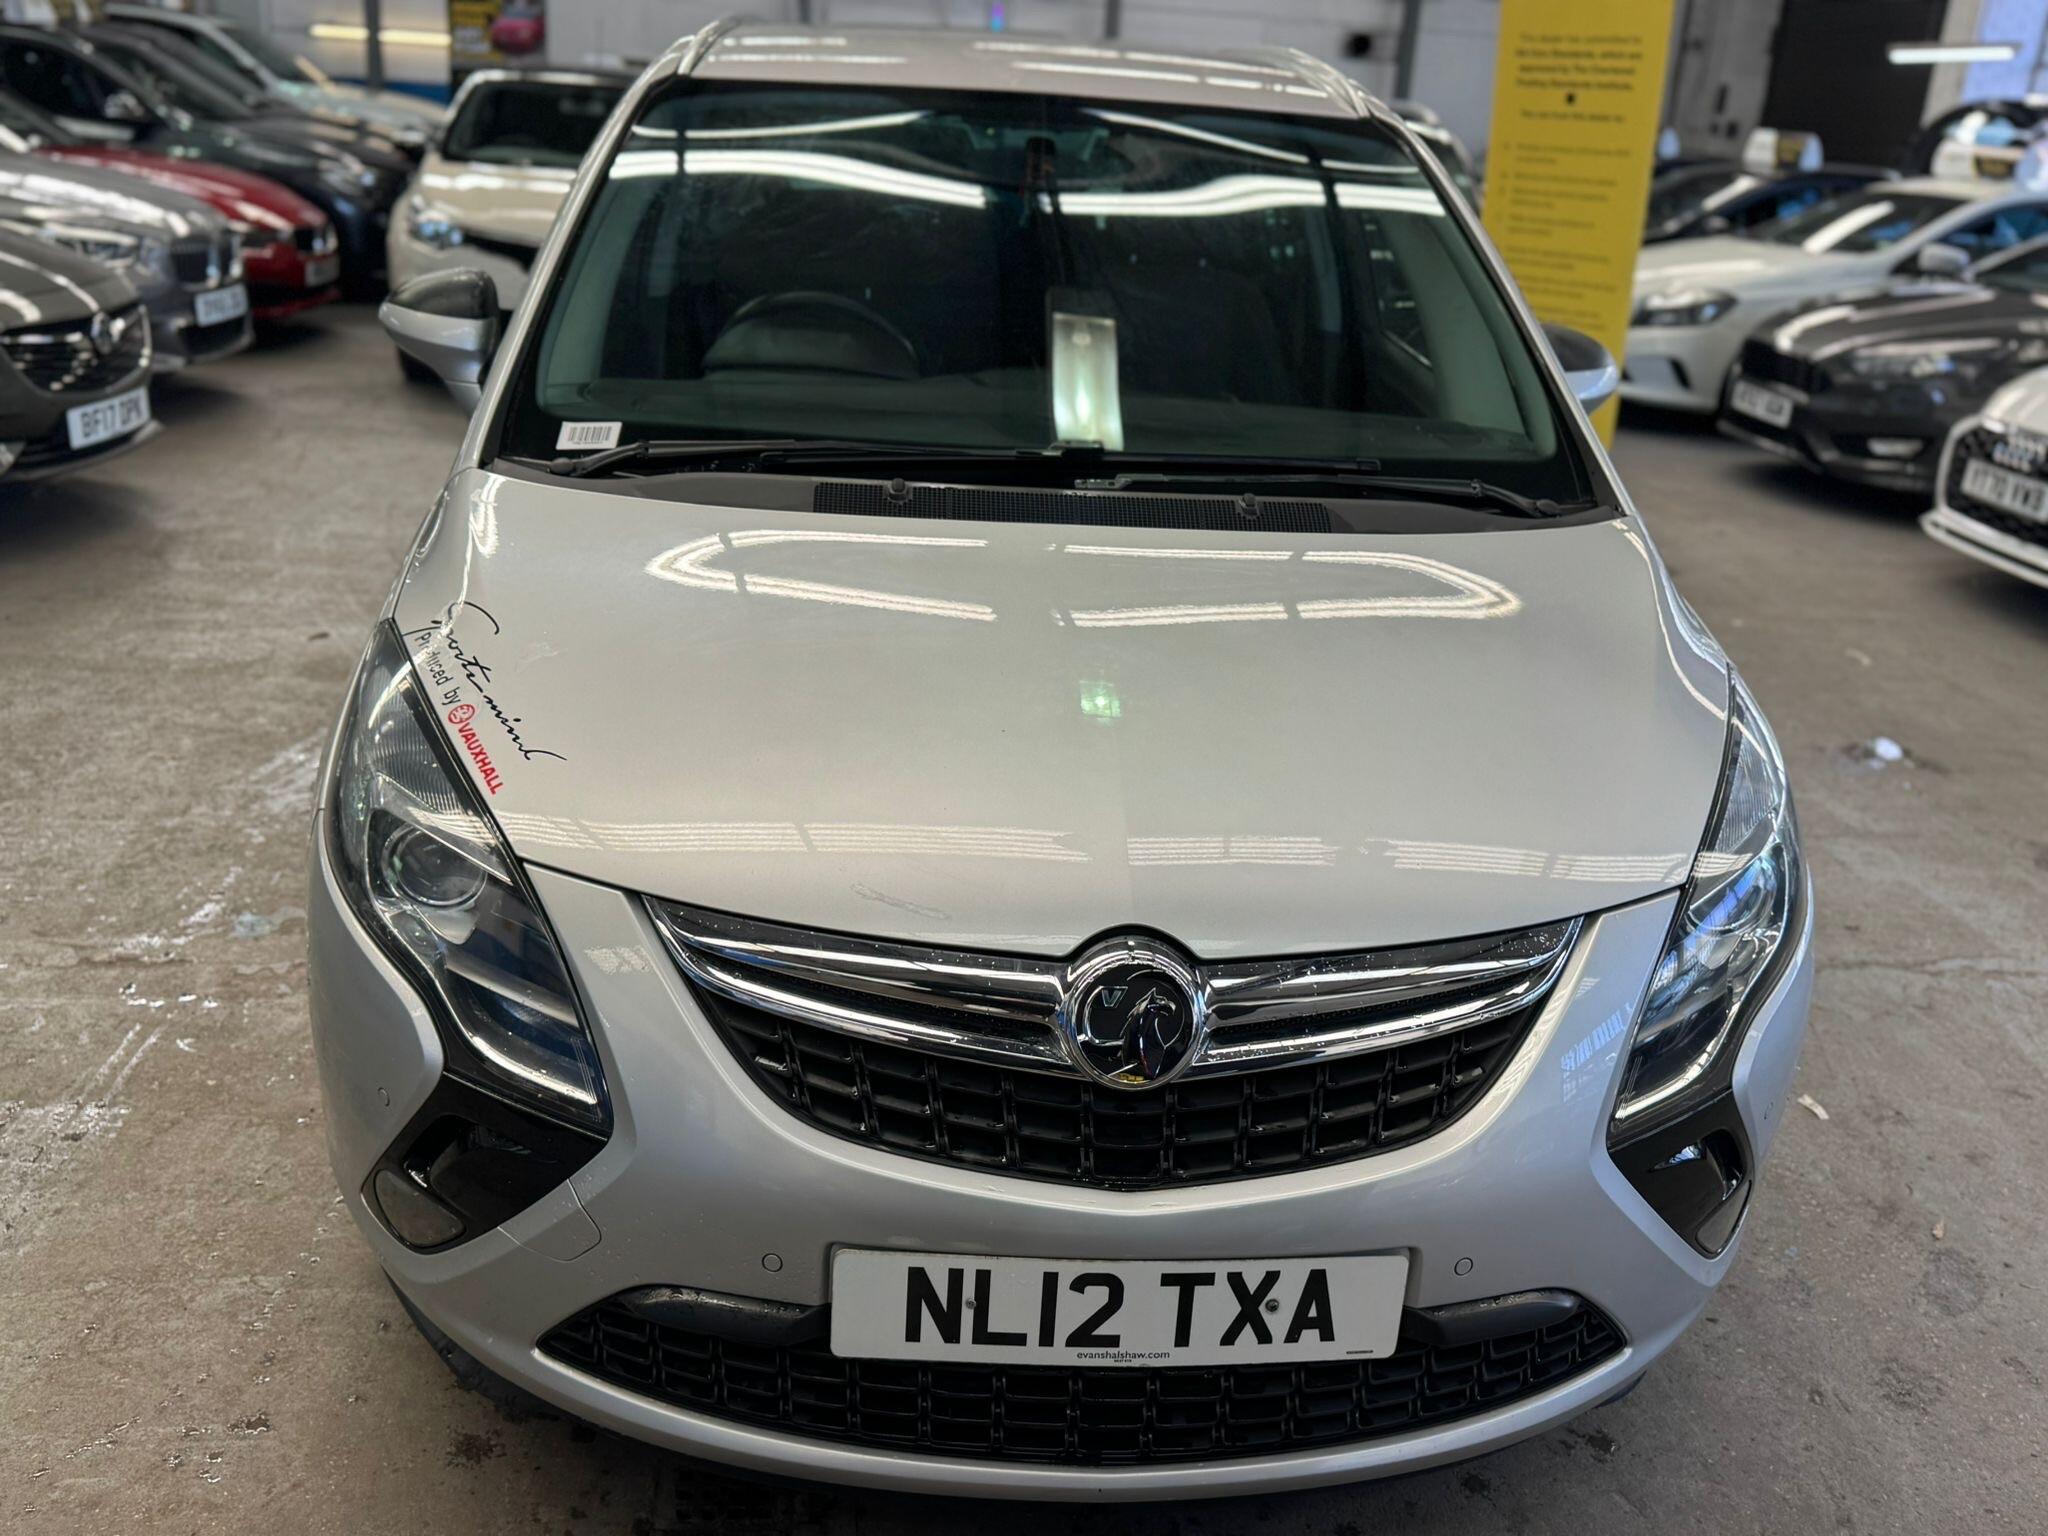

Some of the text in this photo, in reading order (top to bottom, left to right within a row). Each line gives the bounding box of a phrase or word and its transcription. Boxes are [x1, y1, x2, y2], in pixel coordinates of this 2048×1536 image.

[414, 632, 504, 795] Prduced by VAUXHALL
[905, 1266, 1336, 1348] NL12 TXA
[1076, 1350, 1170, 1359] evanshalshaw.com
